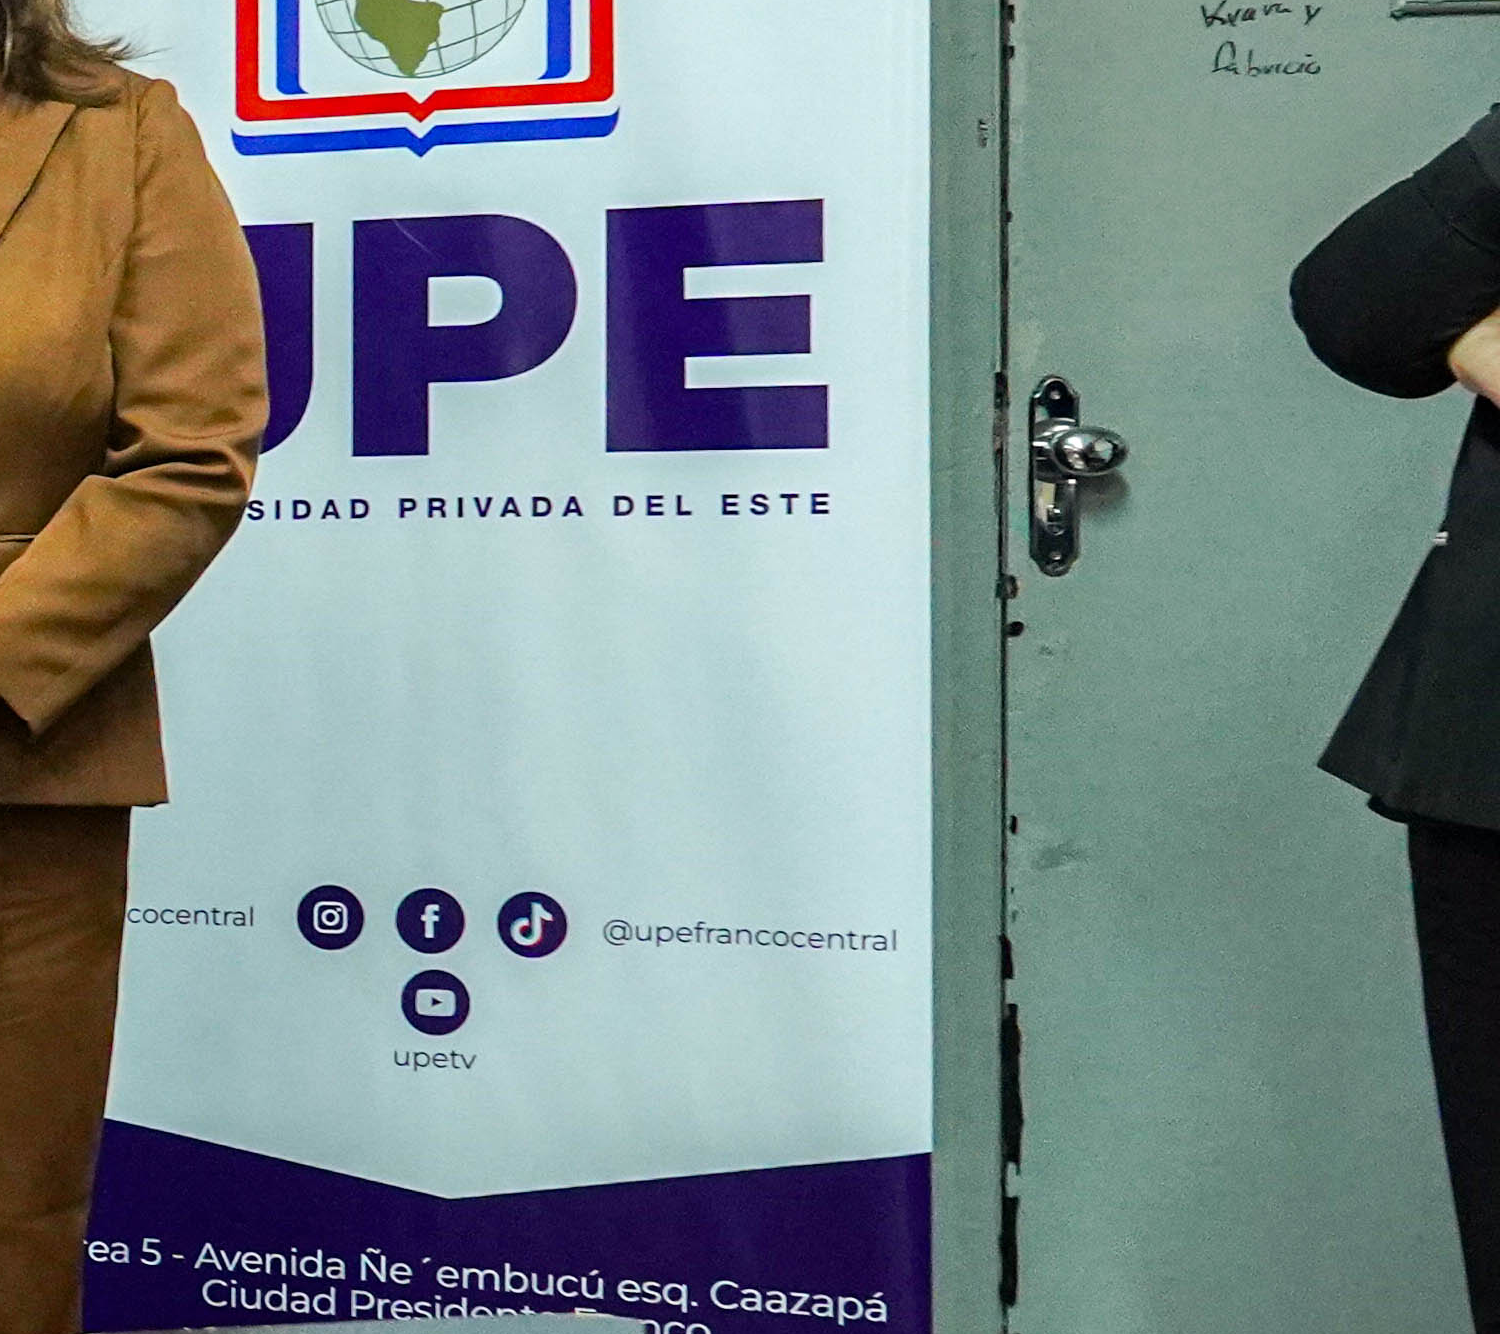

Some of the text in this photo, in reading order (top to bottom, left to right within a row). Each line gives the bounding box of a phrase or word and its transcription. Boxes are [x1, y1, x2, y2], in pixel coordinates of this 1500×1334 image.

[398, 496, 584, 519] PRIVADA
[612, 494, 693, 517] DEL
[721, 492, 830, 516] ESTE
[602, 918, 898, 952] @upefrancocentral
[393, 1049, 477, 1070] upetv
[140, 1237, 162, 1266] 5
[194, 1242, 346, 1280] Avenida
[616, 1277, 699, 1313] esq.
[709, 1279, 888, 1327] Caazapá
[202, 1279, 337, 1316] Ciudad
